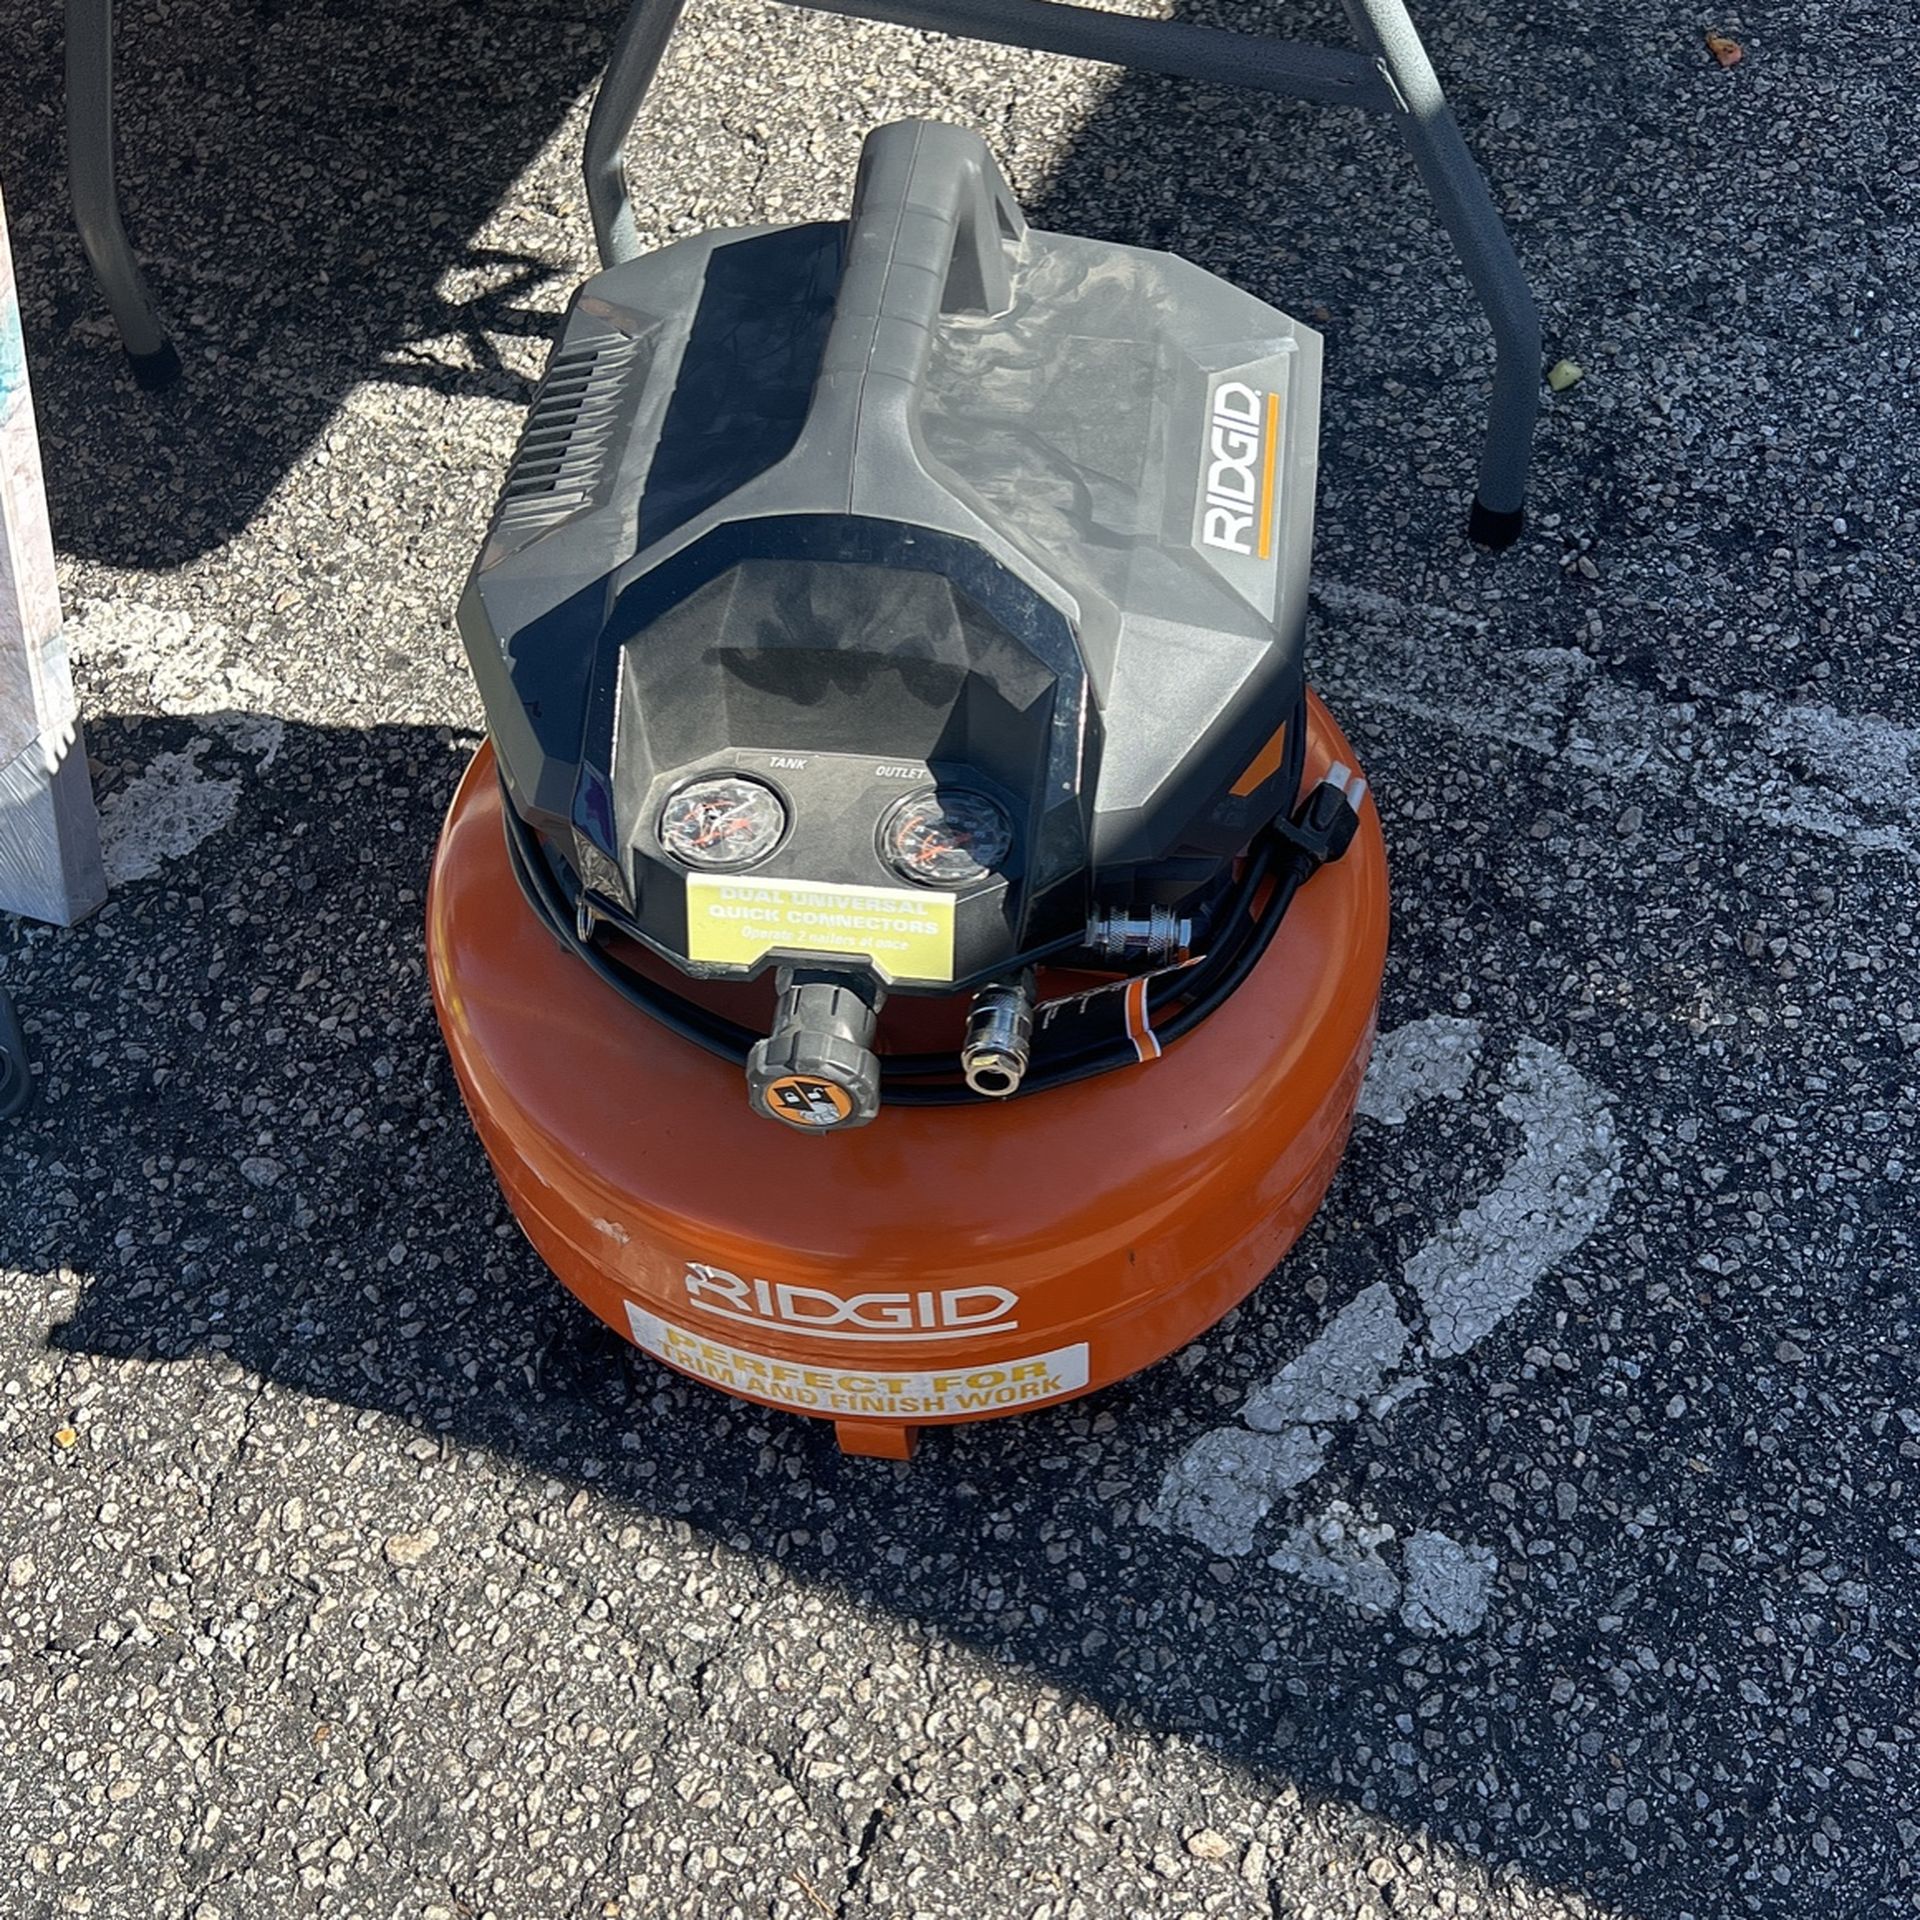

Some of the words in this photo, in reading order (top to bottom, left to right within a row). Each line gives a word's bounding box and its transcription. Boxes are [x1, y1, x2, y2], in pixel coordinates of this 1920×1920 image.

[1203, 381, 1262, 555] RIDGID
[769, 756, 808, 770] TANK
[876, 765, 926, 780] OUTLET
[720, 886, 785, 904] DUAL
[790, 891, 928, 915] UNIVERSAL
[709, 905, 780, 923] QUICK
[786, 911, 940, 936] CONNECTORS
[741, 925, 794, 941] Operate
[799, 931, 806, 941] 2
[808, 932, 855, 946] nailers
[875, 939, 909, 951] once
[685, 1260, 1020, 1329] RIDGID
[656, 1337, 736, 1385] TRIM
[747, 1376, 819, 1405] AND
[830, 1392, 945, 1413] FINISH
[955, 1374, 1063, 1410] WORK
[666, 1328, 912, 1395] PERFECT
[933, 1360, 1048, 1393] FOR
